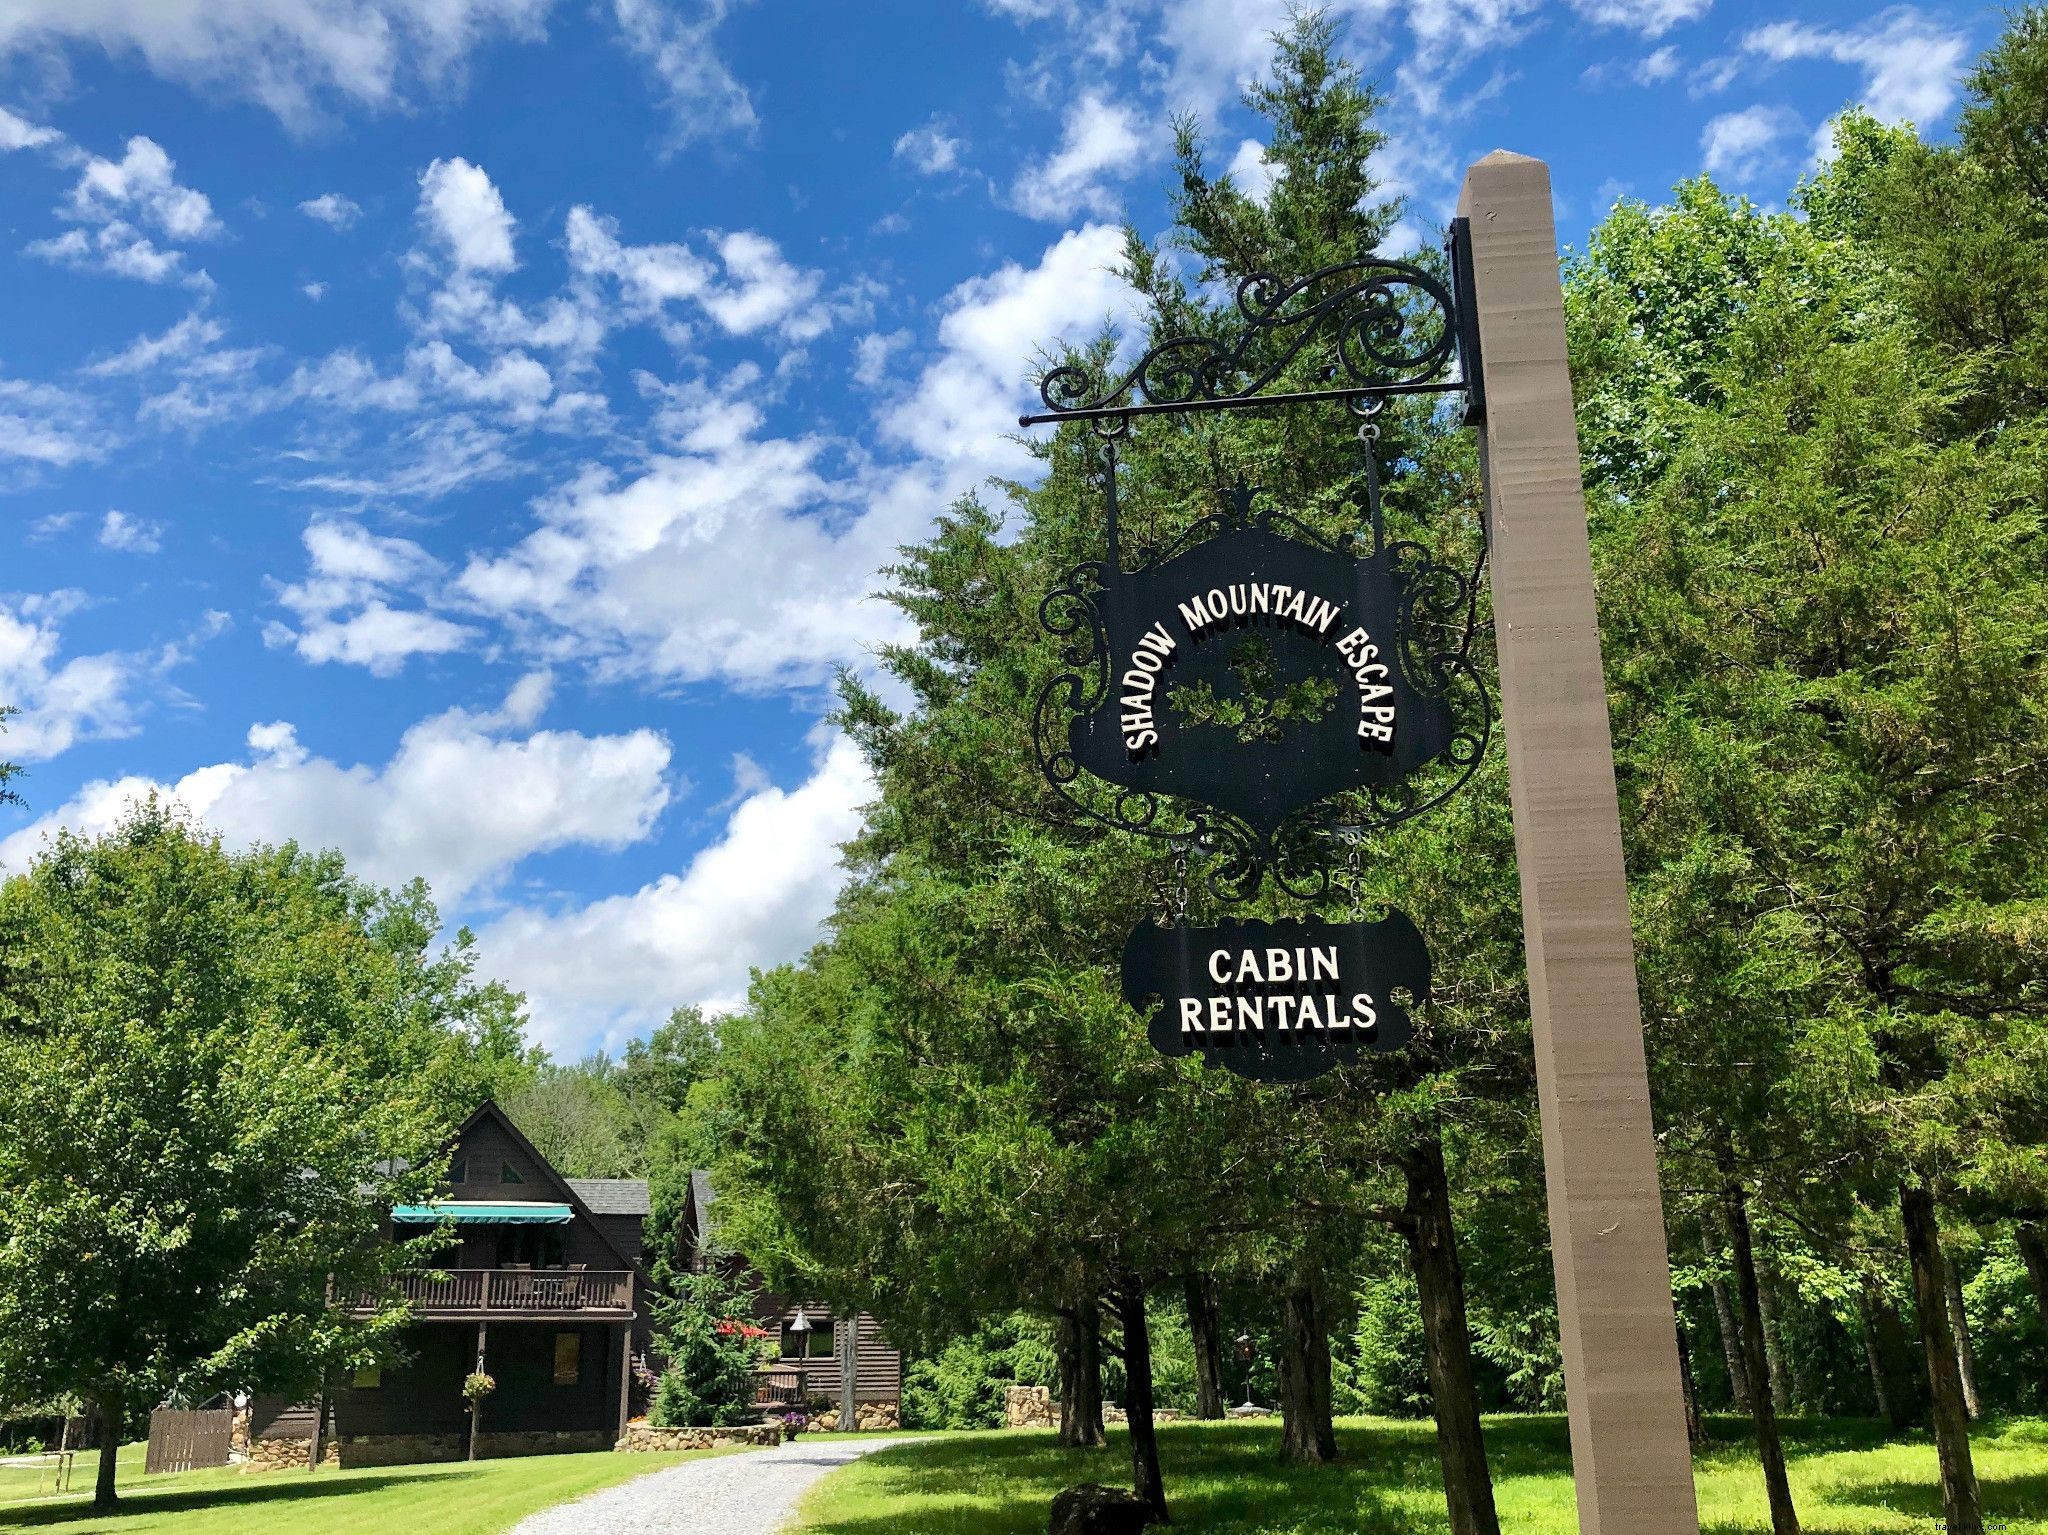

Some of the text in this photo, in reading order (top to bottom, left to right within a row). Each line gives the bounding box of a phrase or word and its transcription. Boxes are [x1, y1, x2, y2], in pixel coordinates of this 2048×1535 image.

[1120, 583, 1395, 749] SHADOW MOUNTAIN ESCAPE
[1208, 946, 1339, 983] CABIN
[1179, 993, 1377, 1031] RENTALS
